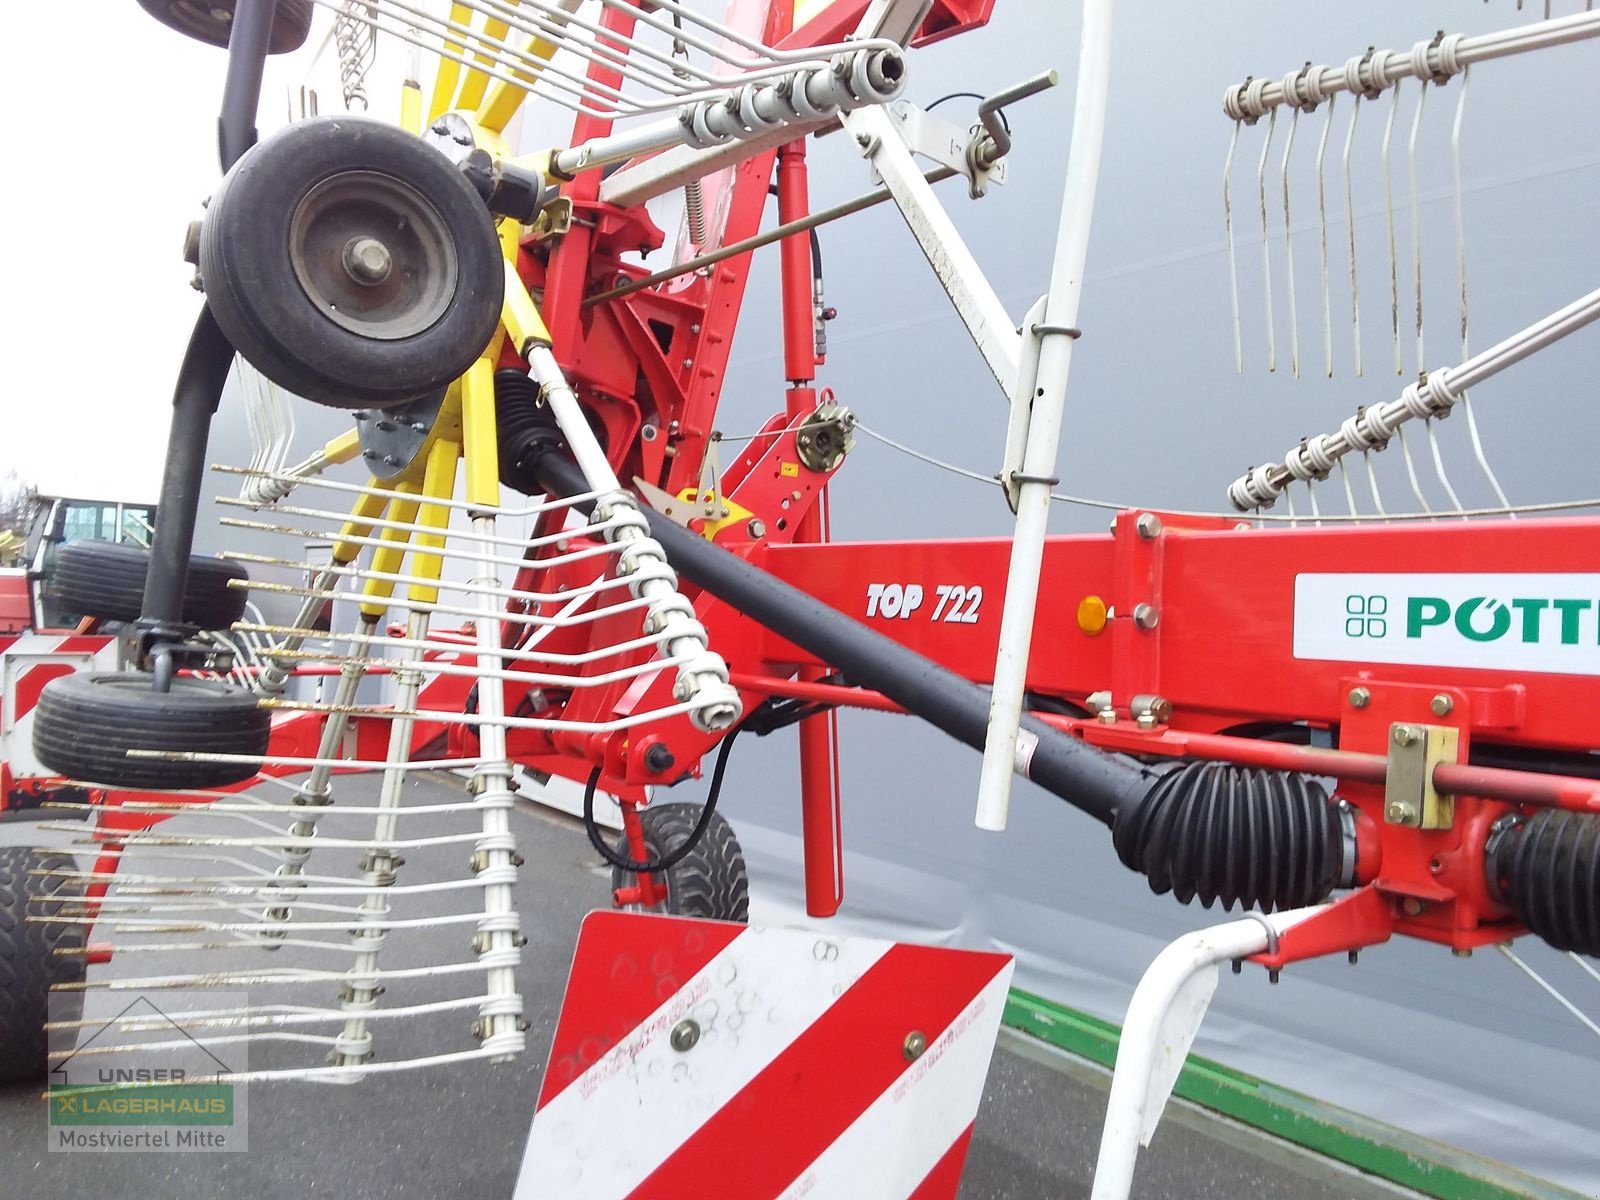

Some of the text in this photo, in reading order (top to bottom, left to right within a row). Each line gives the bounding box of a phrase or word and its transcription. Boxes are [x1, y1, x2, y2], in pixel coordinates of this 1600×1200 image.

[866, 583, 983, 624] TOP 722
[1406, 596, 1600, 646] PÖTT
